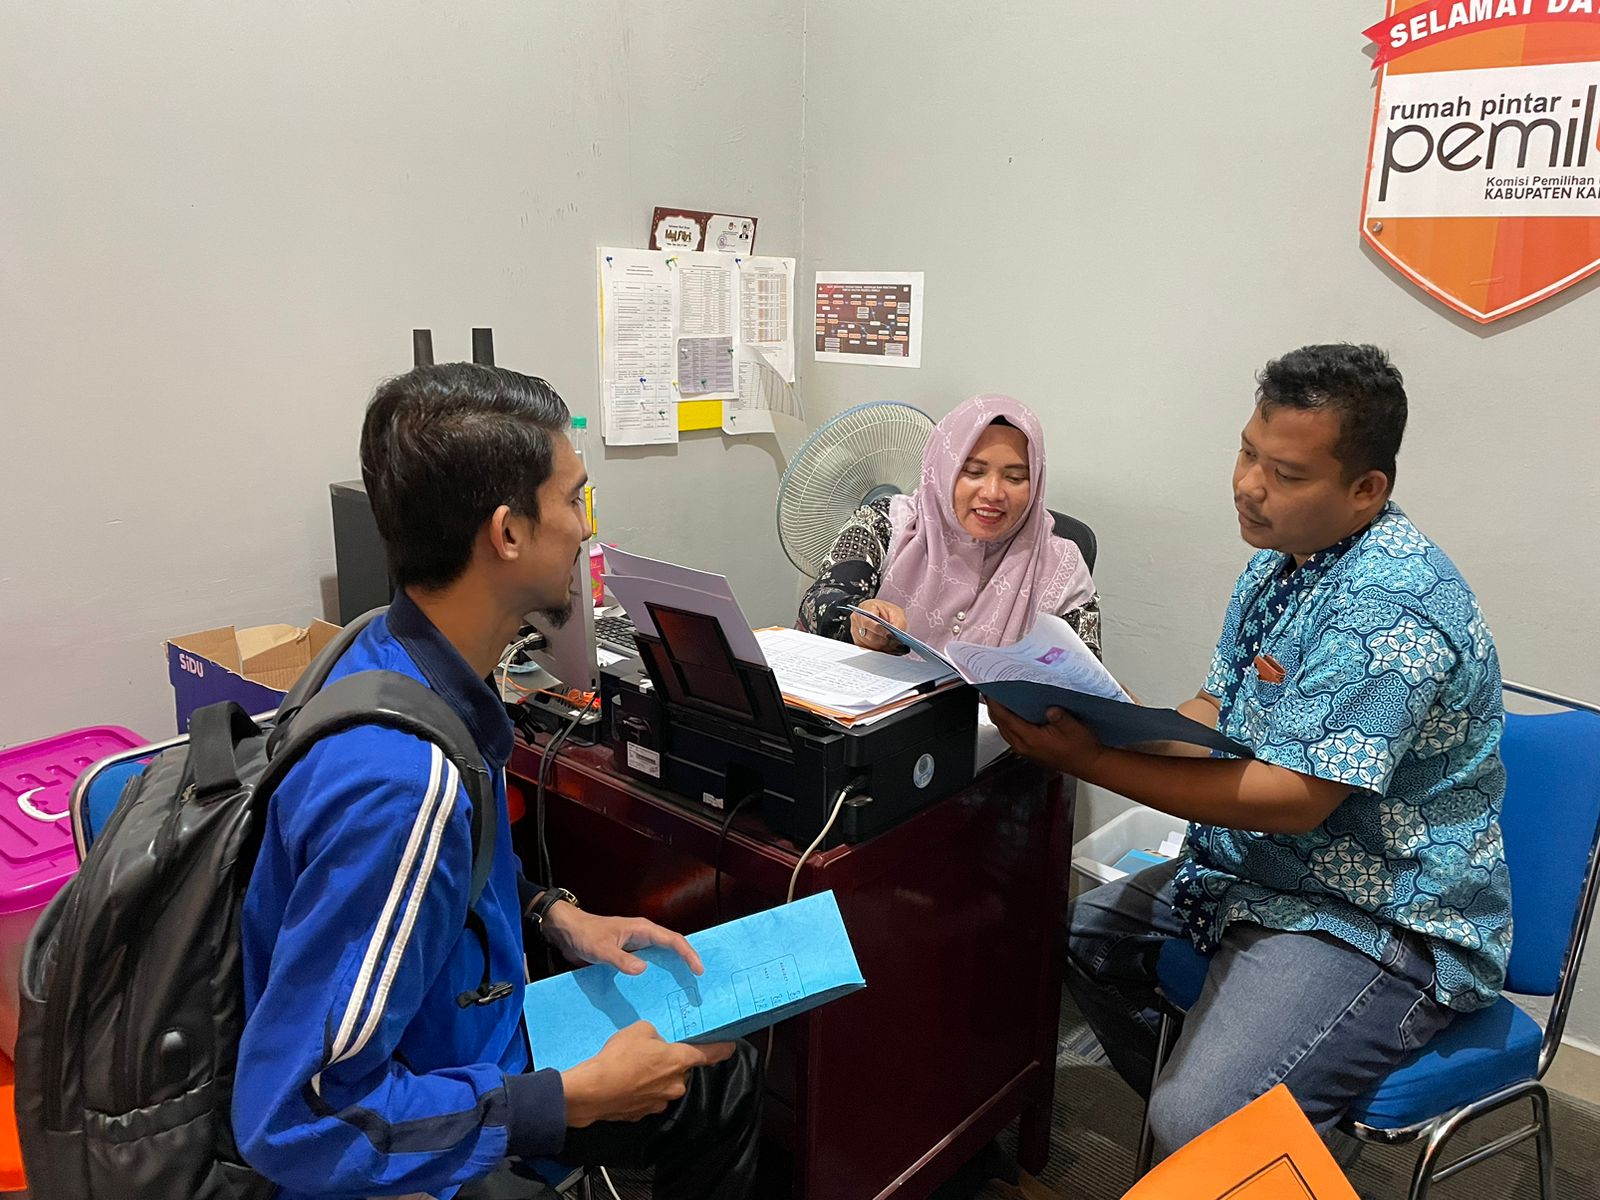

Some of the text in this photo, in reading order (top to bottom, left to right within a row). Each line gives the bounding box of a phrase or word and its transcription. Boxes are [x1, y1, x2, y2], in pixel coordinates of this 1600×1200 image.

[1390, 93, 1562, 121] rumah pintar
[1378, 85, 1600, 202] pemil
[1486, 175, 1595, 187] Komisi Pemilihan
[1484, 187, 1600, 200] KABUPATEN KA
